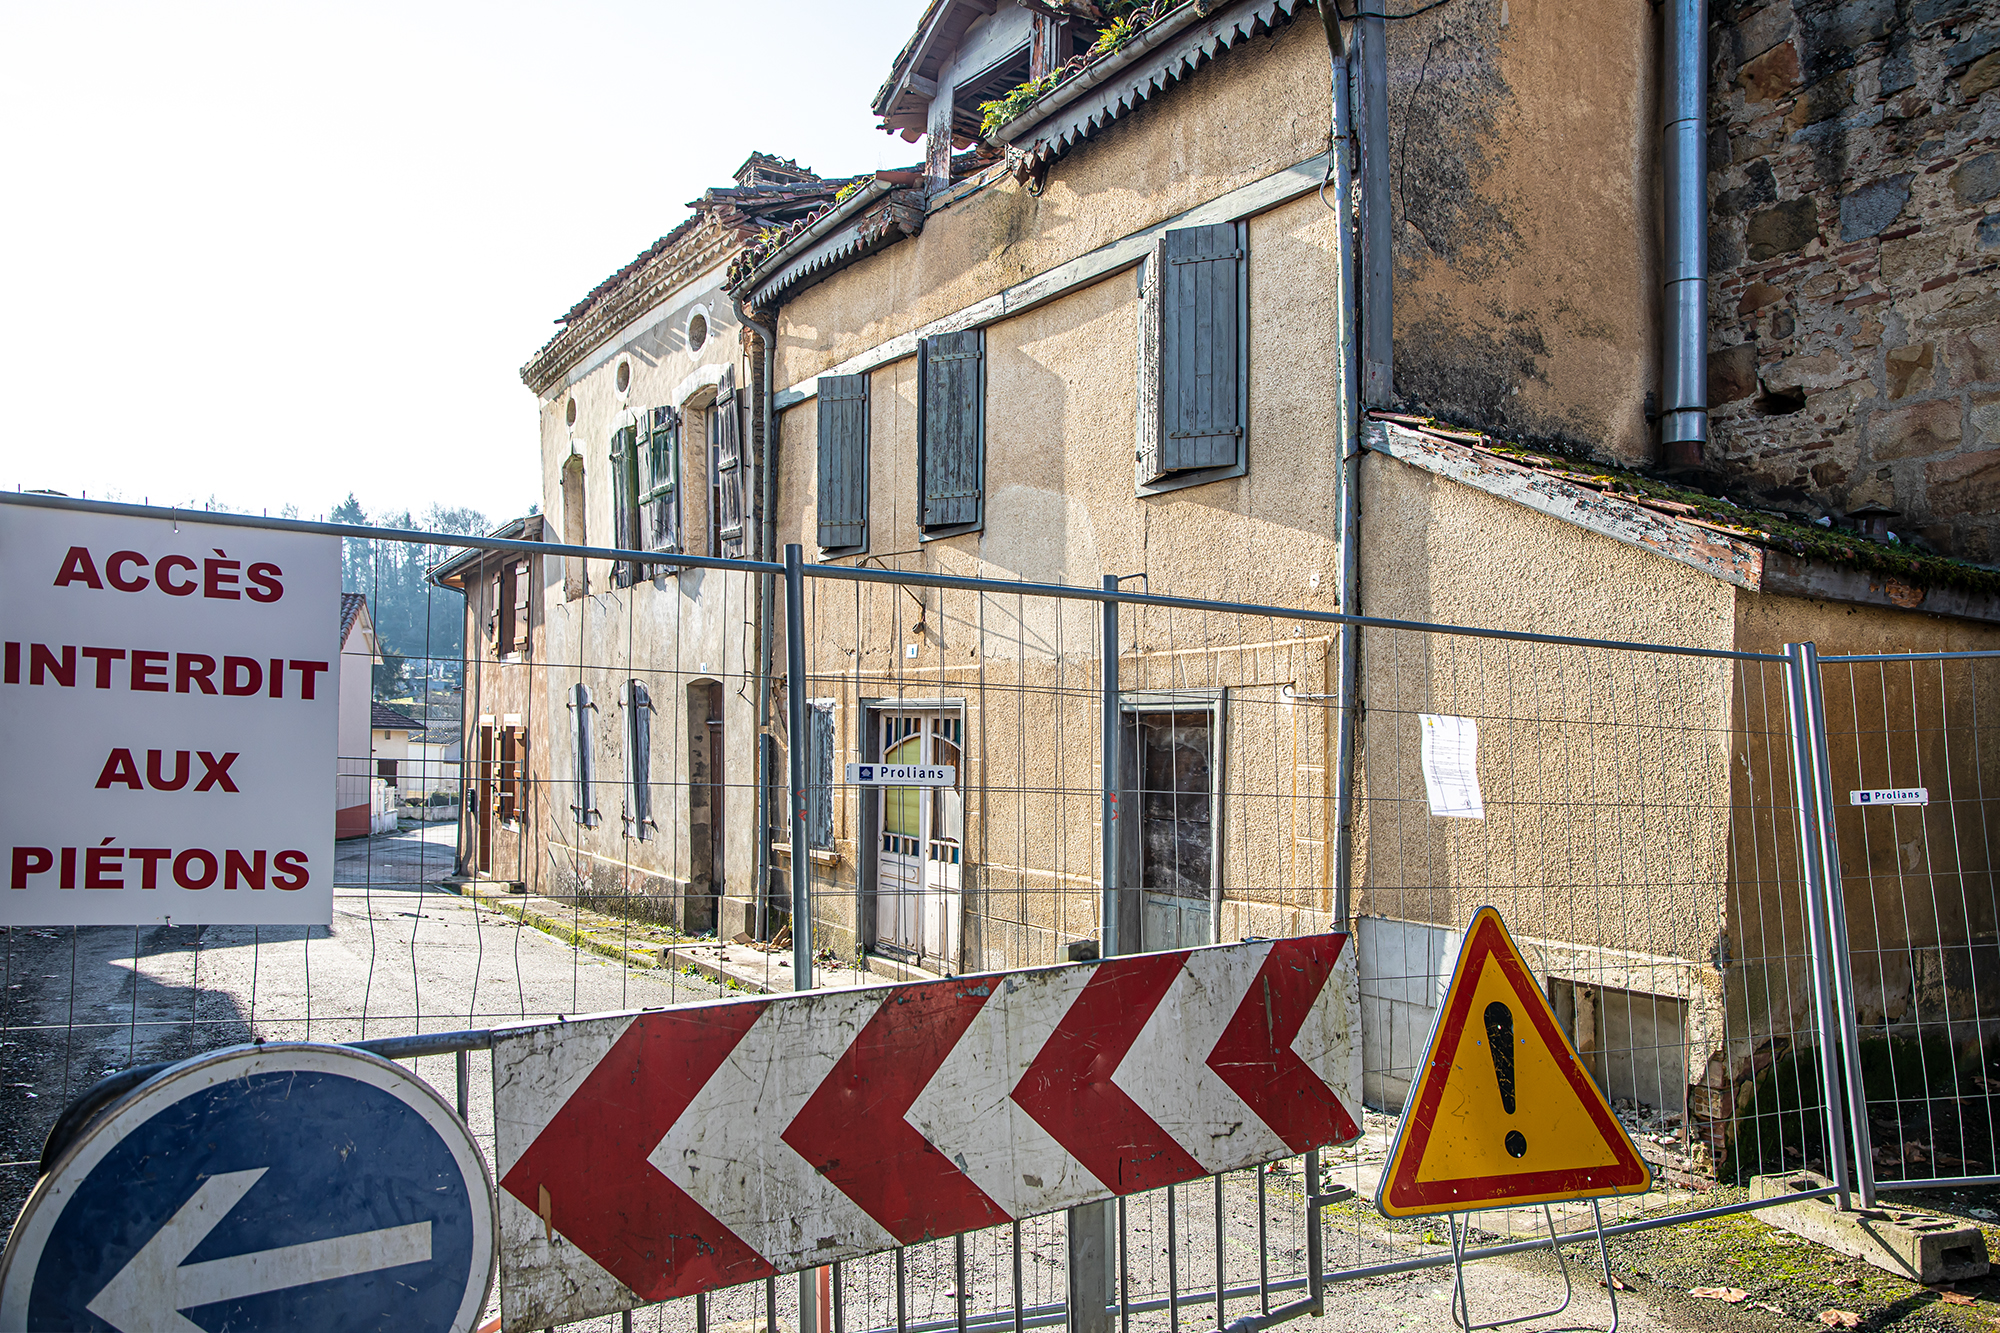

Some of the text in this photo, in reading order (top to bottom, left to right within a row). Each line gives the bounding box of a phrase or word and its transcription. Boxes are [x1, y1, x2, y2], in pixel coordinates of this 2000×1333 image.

[53, 546, 284, 603] ACCÈS
[3, 641, 329, 701] INTERDIT
[95, 748, 240, 793] AUX
[880, 766, 944, 779] Prolians
[1874, 790, 1920, 800] Prolians
[11, 836, 310, 891] PIÉTONS
